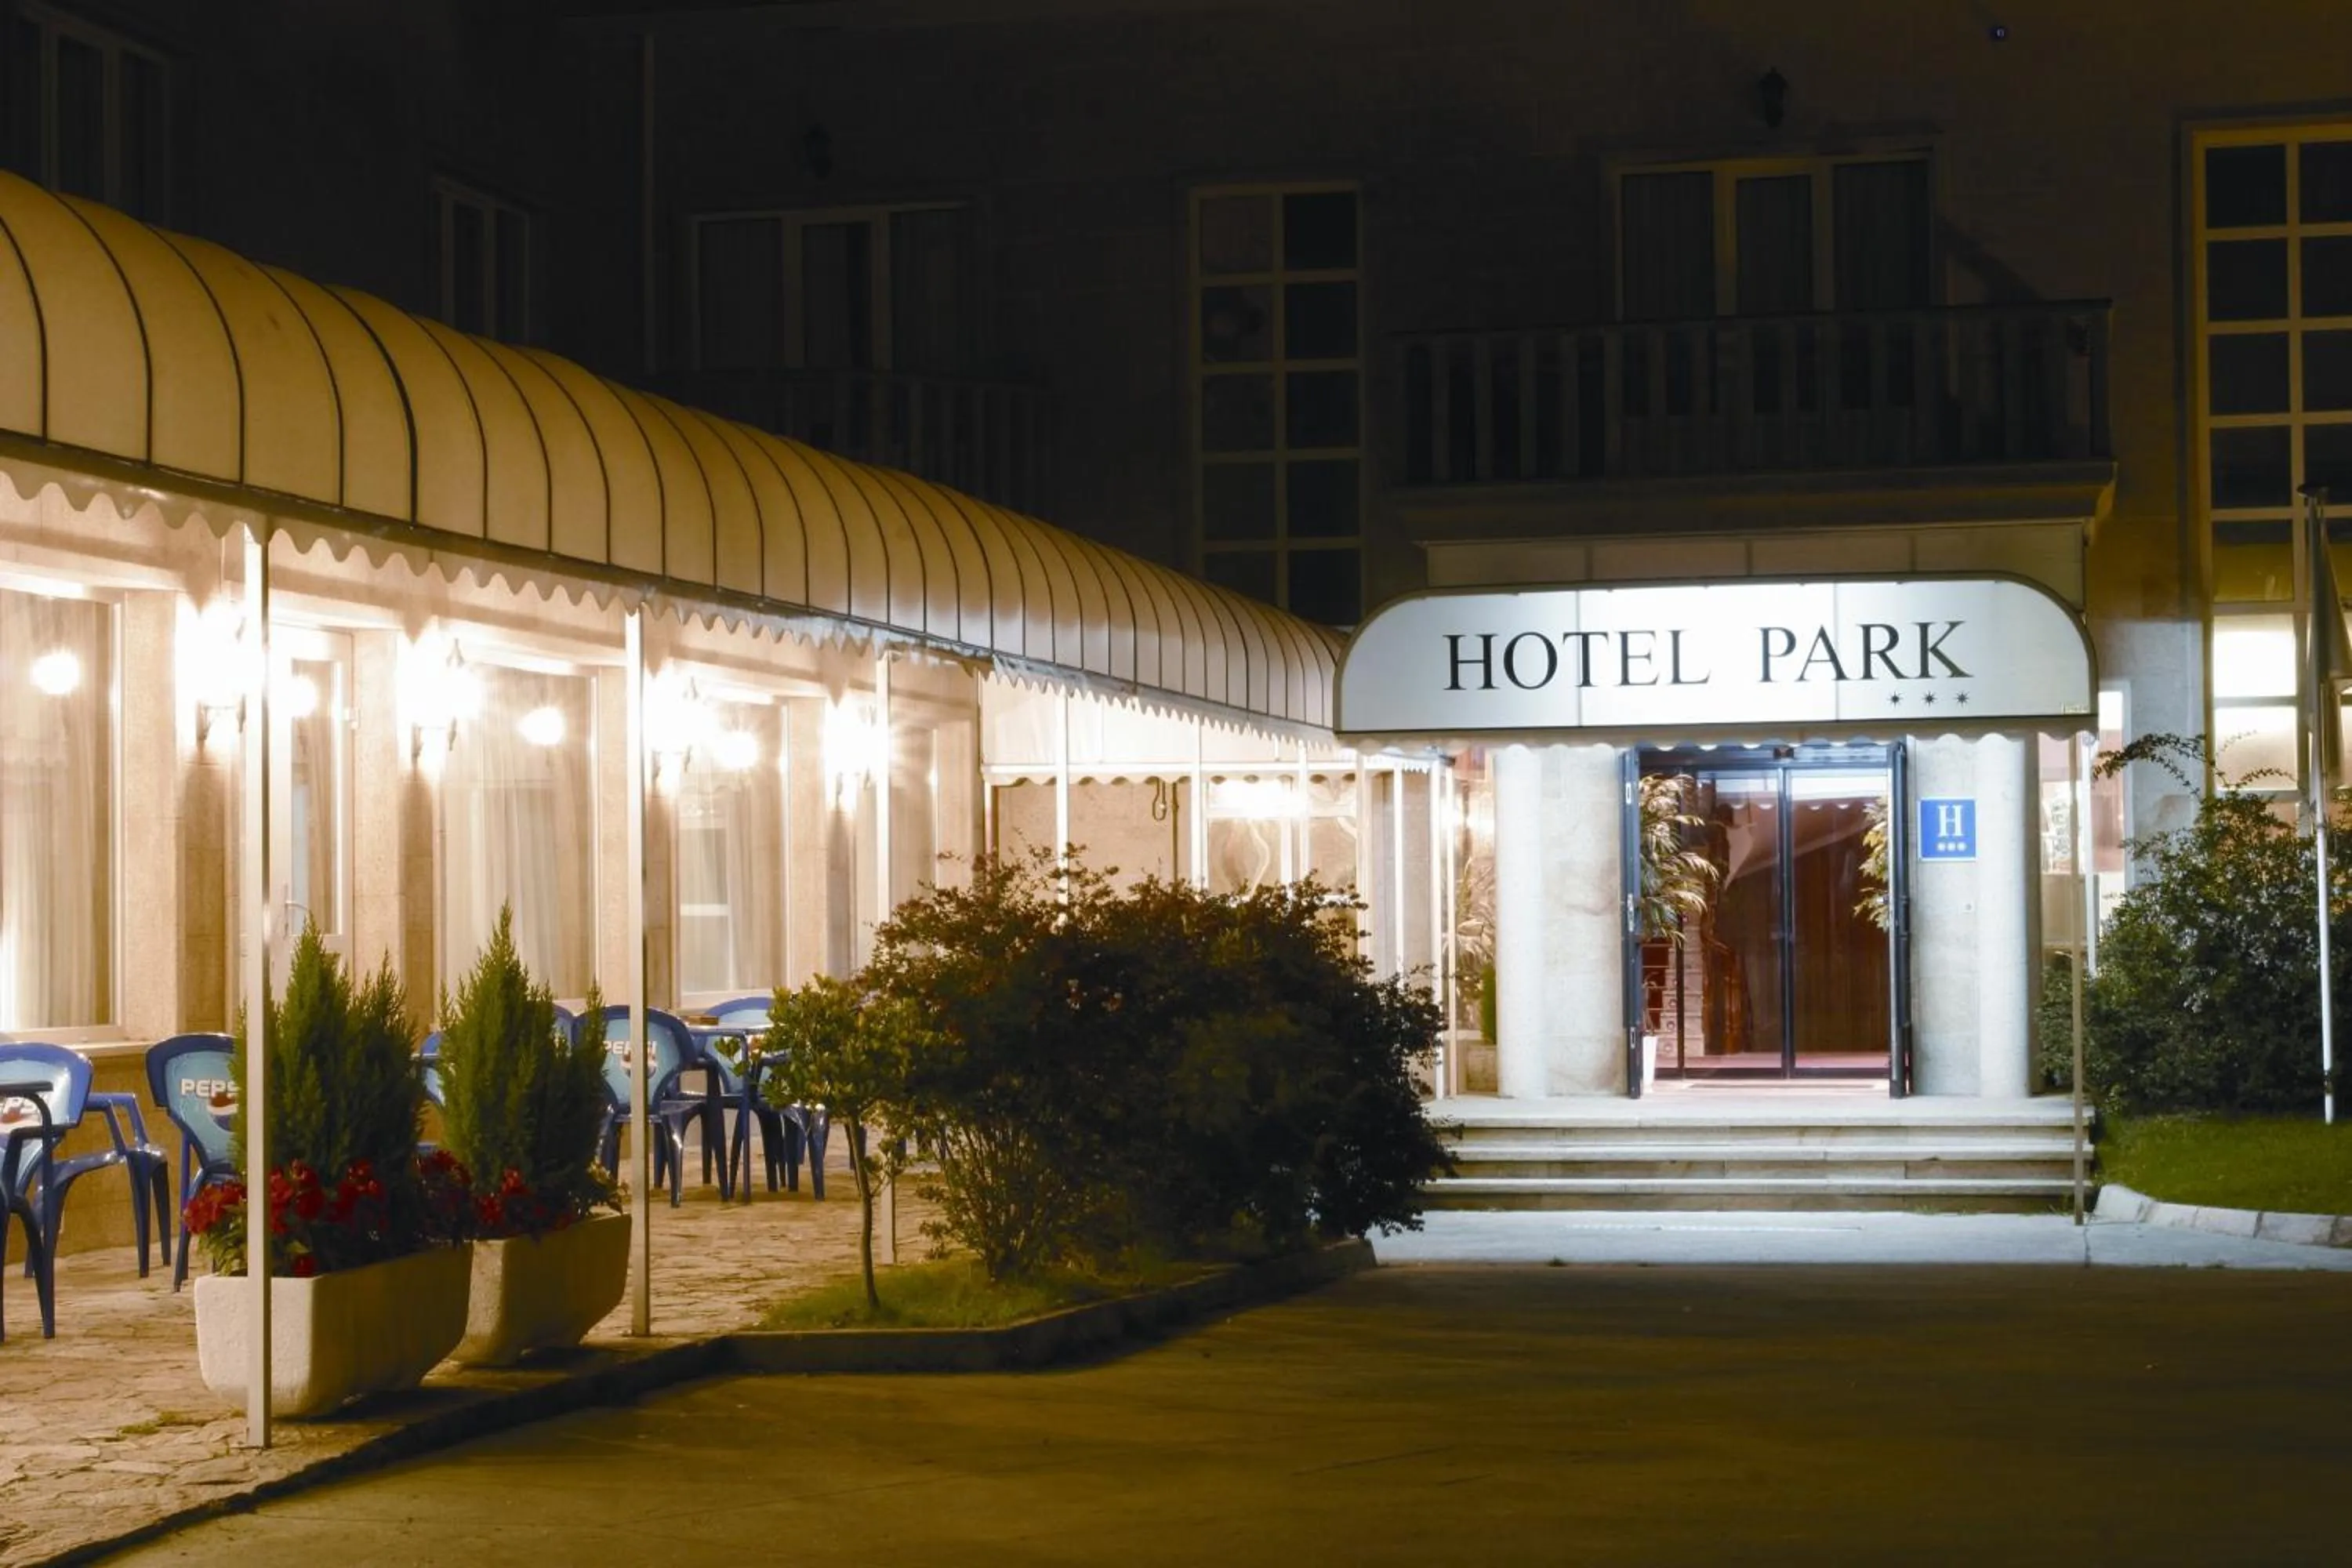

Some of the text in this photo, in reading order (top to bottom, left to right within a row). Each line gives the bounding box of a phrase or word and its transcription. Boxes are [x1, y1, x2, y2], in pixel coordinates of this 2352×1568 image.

[1443, 620, 1973, 691] HOTEL PARK
[1937, 804, 1963, 837] H
[181, 1078, 240, 1098] PEPS
